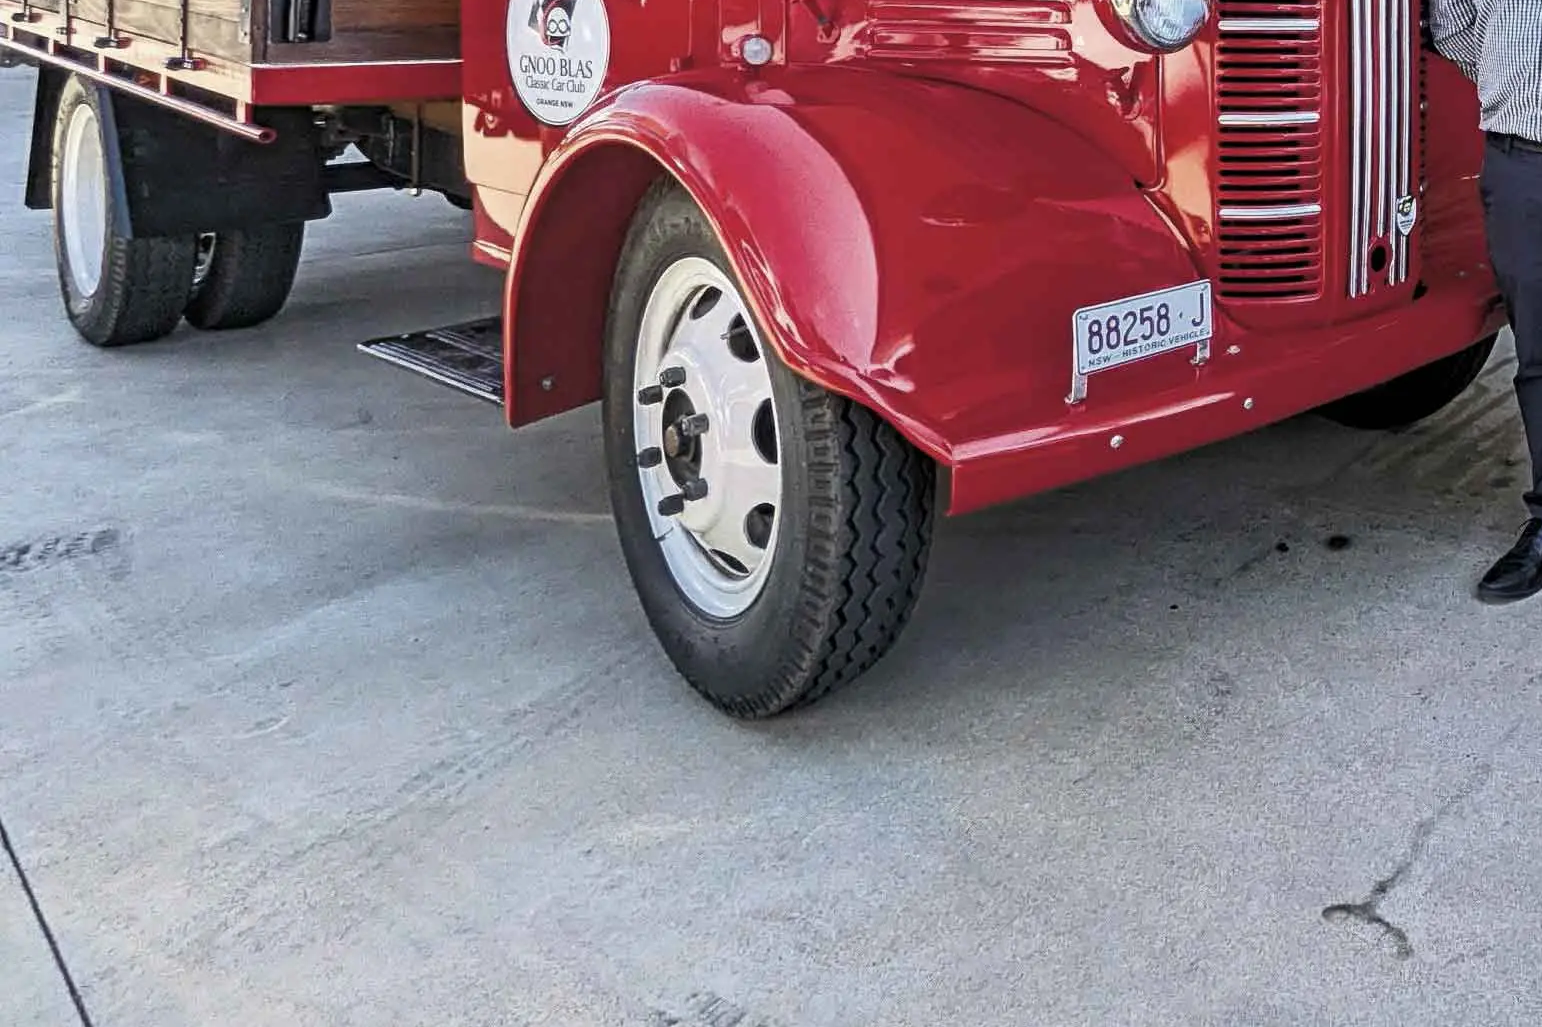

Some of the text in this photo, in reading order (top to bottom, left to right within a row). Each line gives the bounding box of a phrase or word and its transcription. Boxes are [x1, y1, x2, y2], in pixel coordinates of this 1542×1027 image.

[519, 54, 593, 79] GNOO BLAS
[526, 75, 586, 93] Classic Car Club
[536, 98, 559, 107] ORANGE
[1087, 292, 1205, 355] 88258 J
[1088, 328, 1205, 368] NSW HISTORIC VEHICLE
